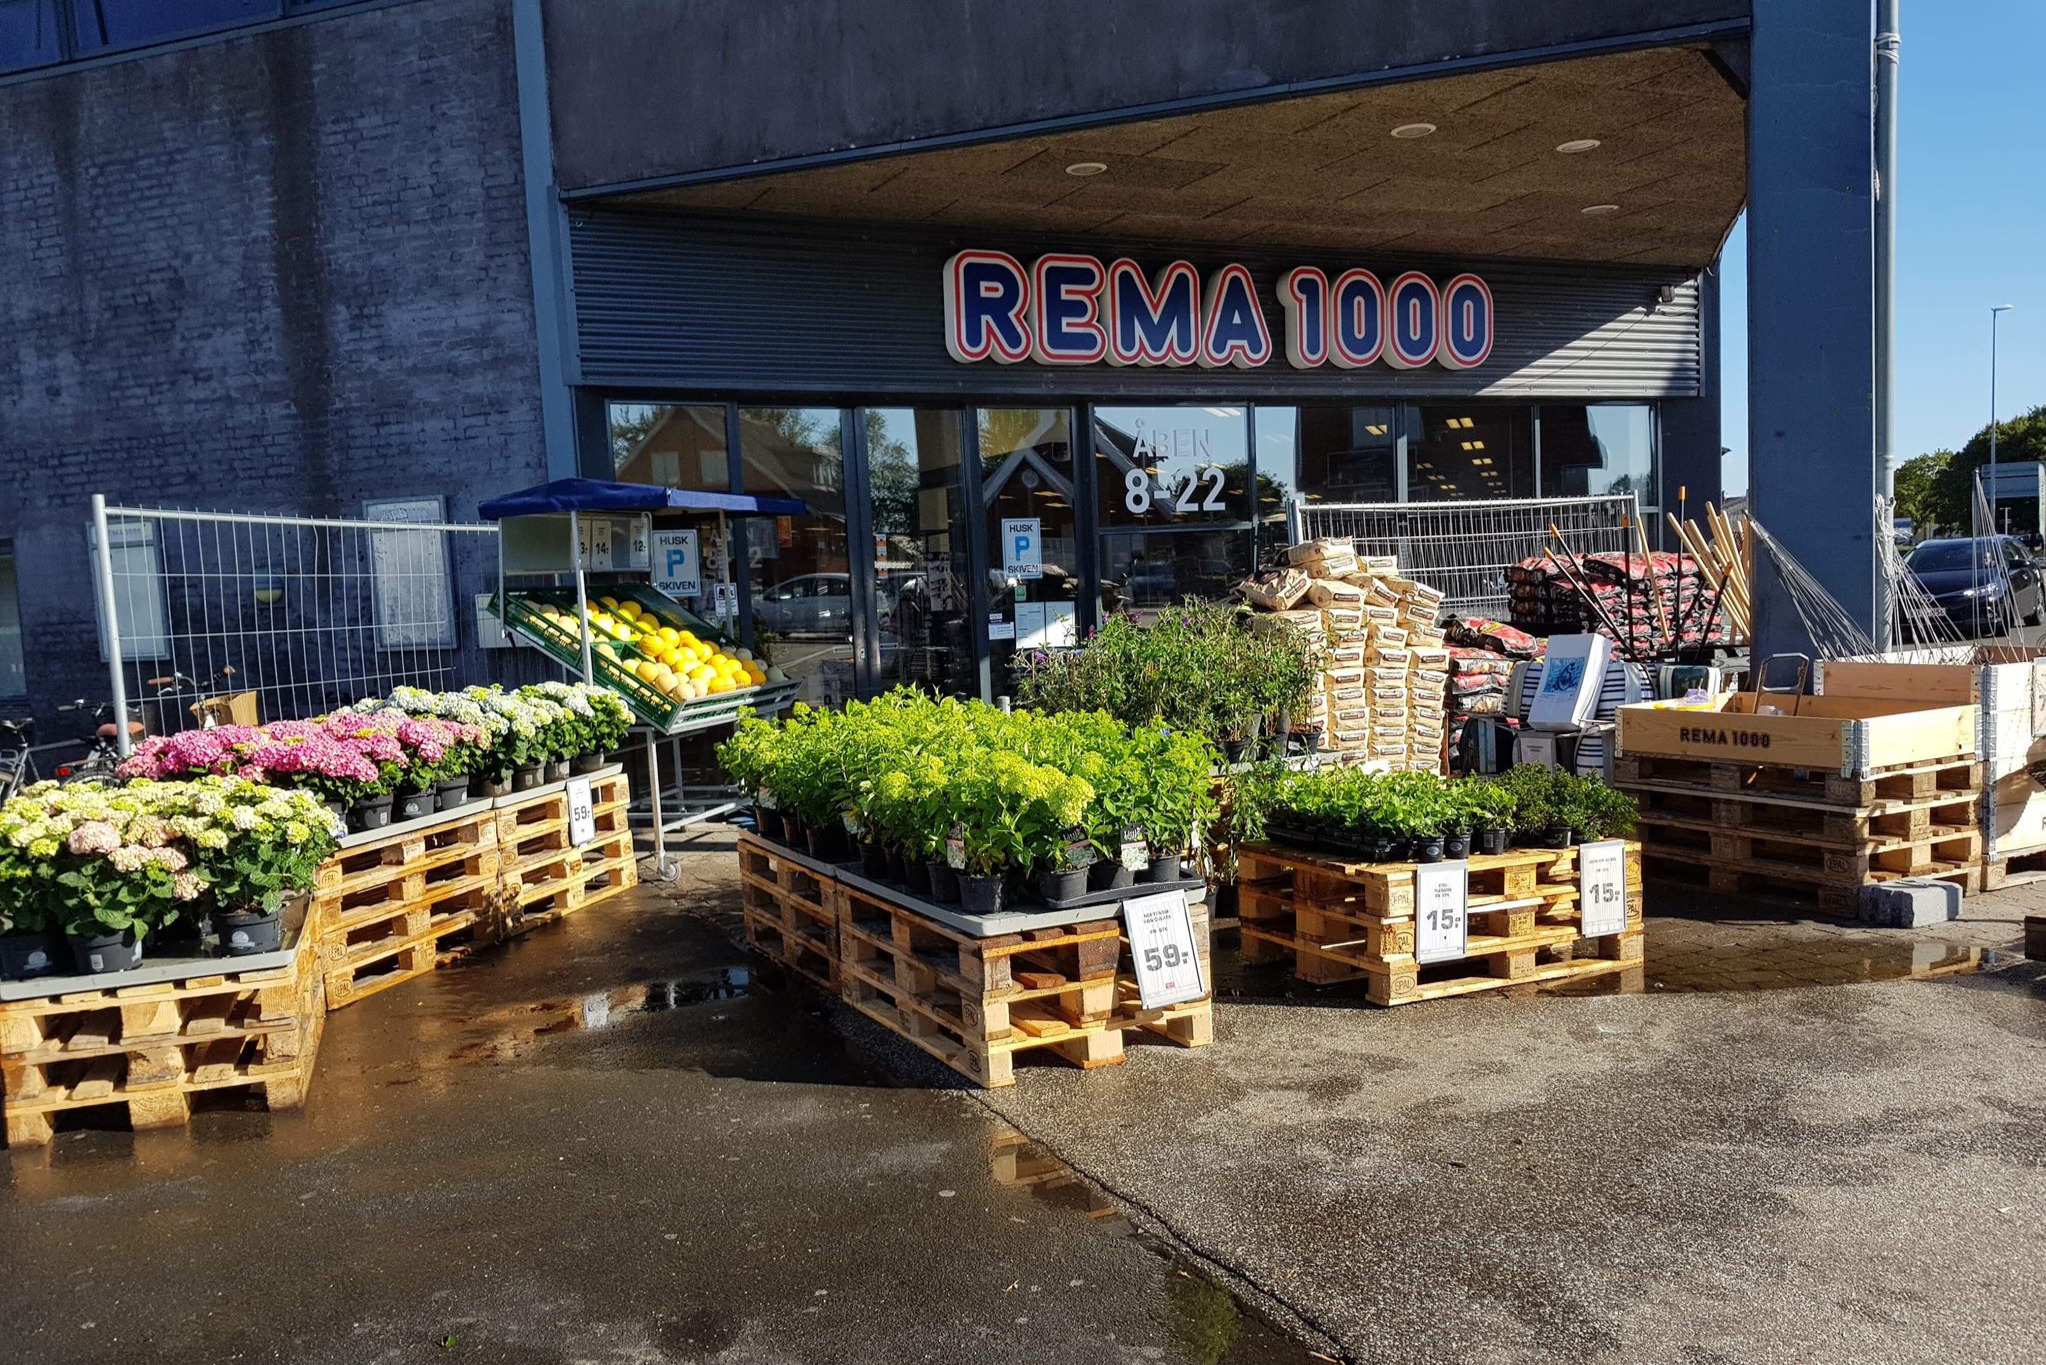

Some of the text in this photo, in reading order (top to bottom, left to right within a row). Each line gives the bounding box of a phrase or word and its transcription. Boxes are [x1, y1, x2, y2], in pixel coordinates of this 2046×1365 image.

[943, 249, 1494, 370] REMA 1000
[1132, 418, 1212, 459] ÅBEN
[1125, 468, 1226, 514] 8-22
[1009, 523, 1034, 533] HUSK
[659, 536, 689, 546] HUSK
[1014, 535, 1030, 562] P
[666, 549, 685, 578] P
[1007, 564, 1039, 574] SKIVEN
[658, 580, 697, 592] SKIVEN
[1680, 727, 1771, 748] REMA 1000
